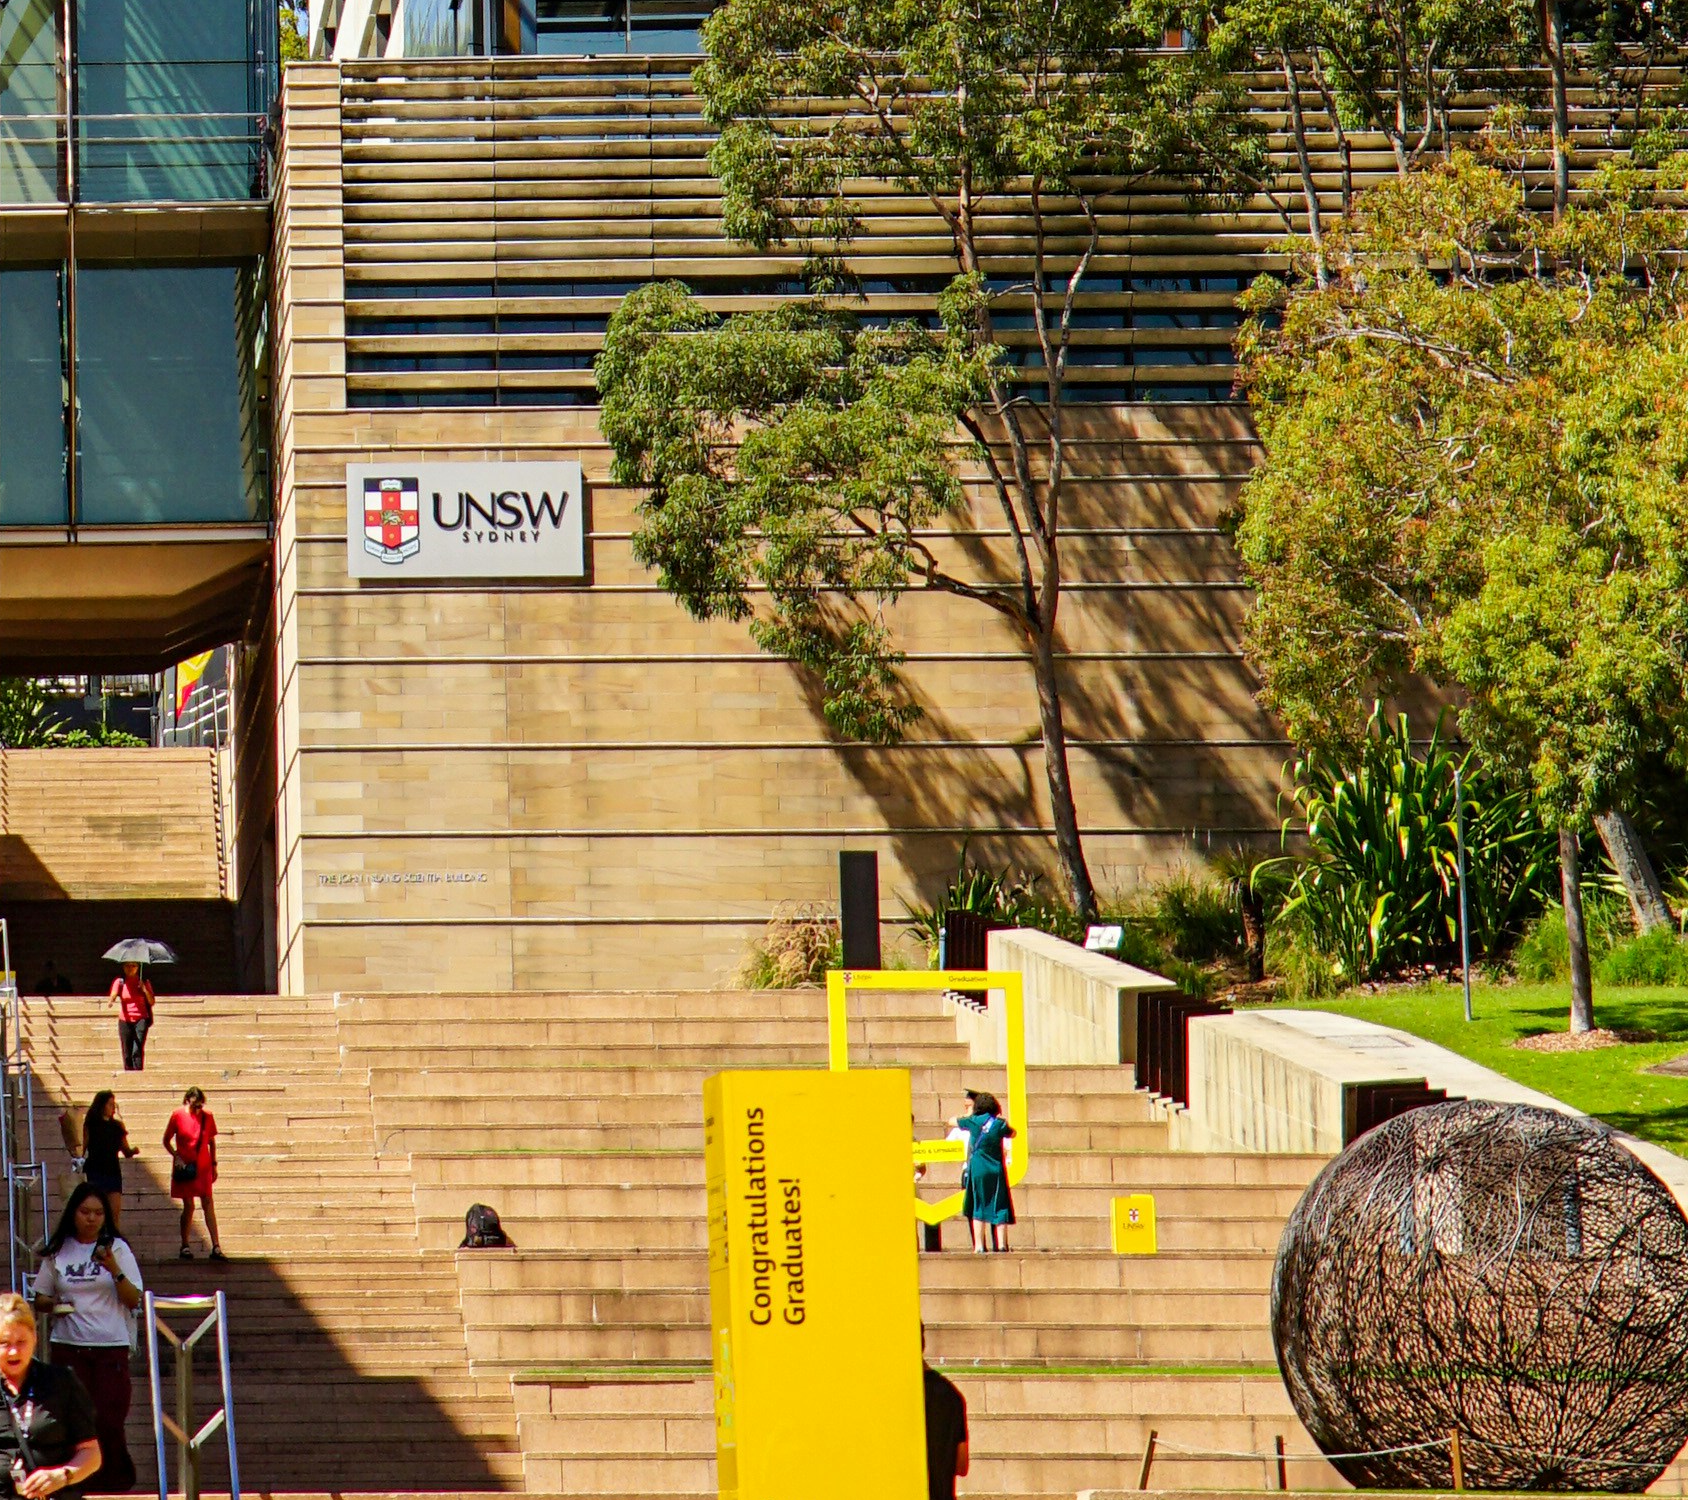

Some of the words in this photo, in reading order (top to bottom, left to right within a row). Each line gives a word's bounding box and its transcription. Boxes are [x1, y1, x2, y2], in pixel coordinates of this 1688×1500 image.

[432, 490, 569, 531] UNSW
[462, 530, 540, 543] SYDNEY
[948, 974, 988, 983] Graduation
[742, 1107, 776, 1326] Congratulations
[777, 1177, 806, 1326] Graduates!
